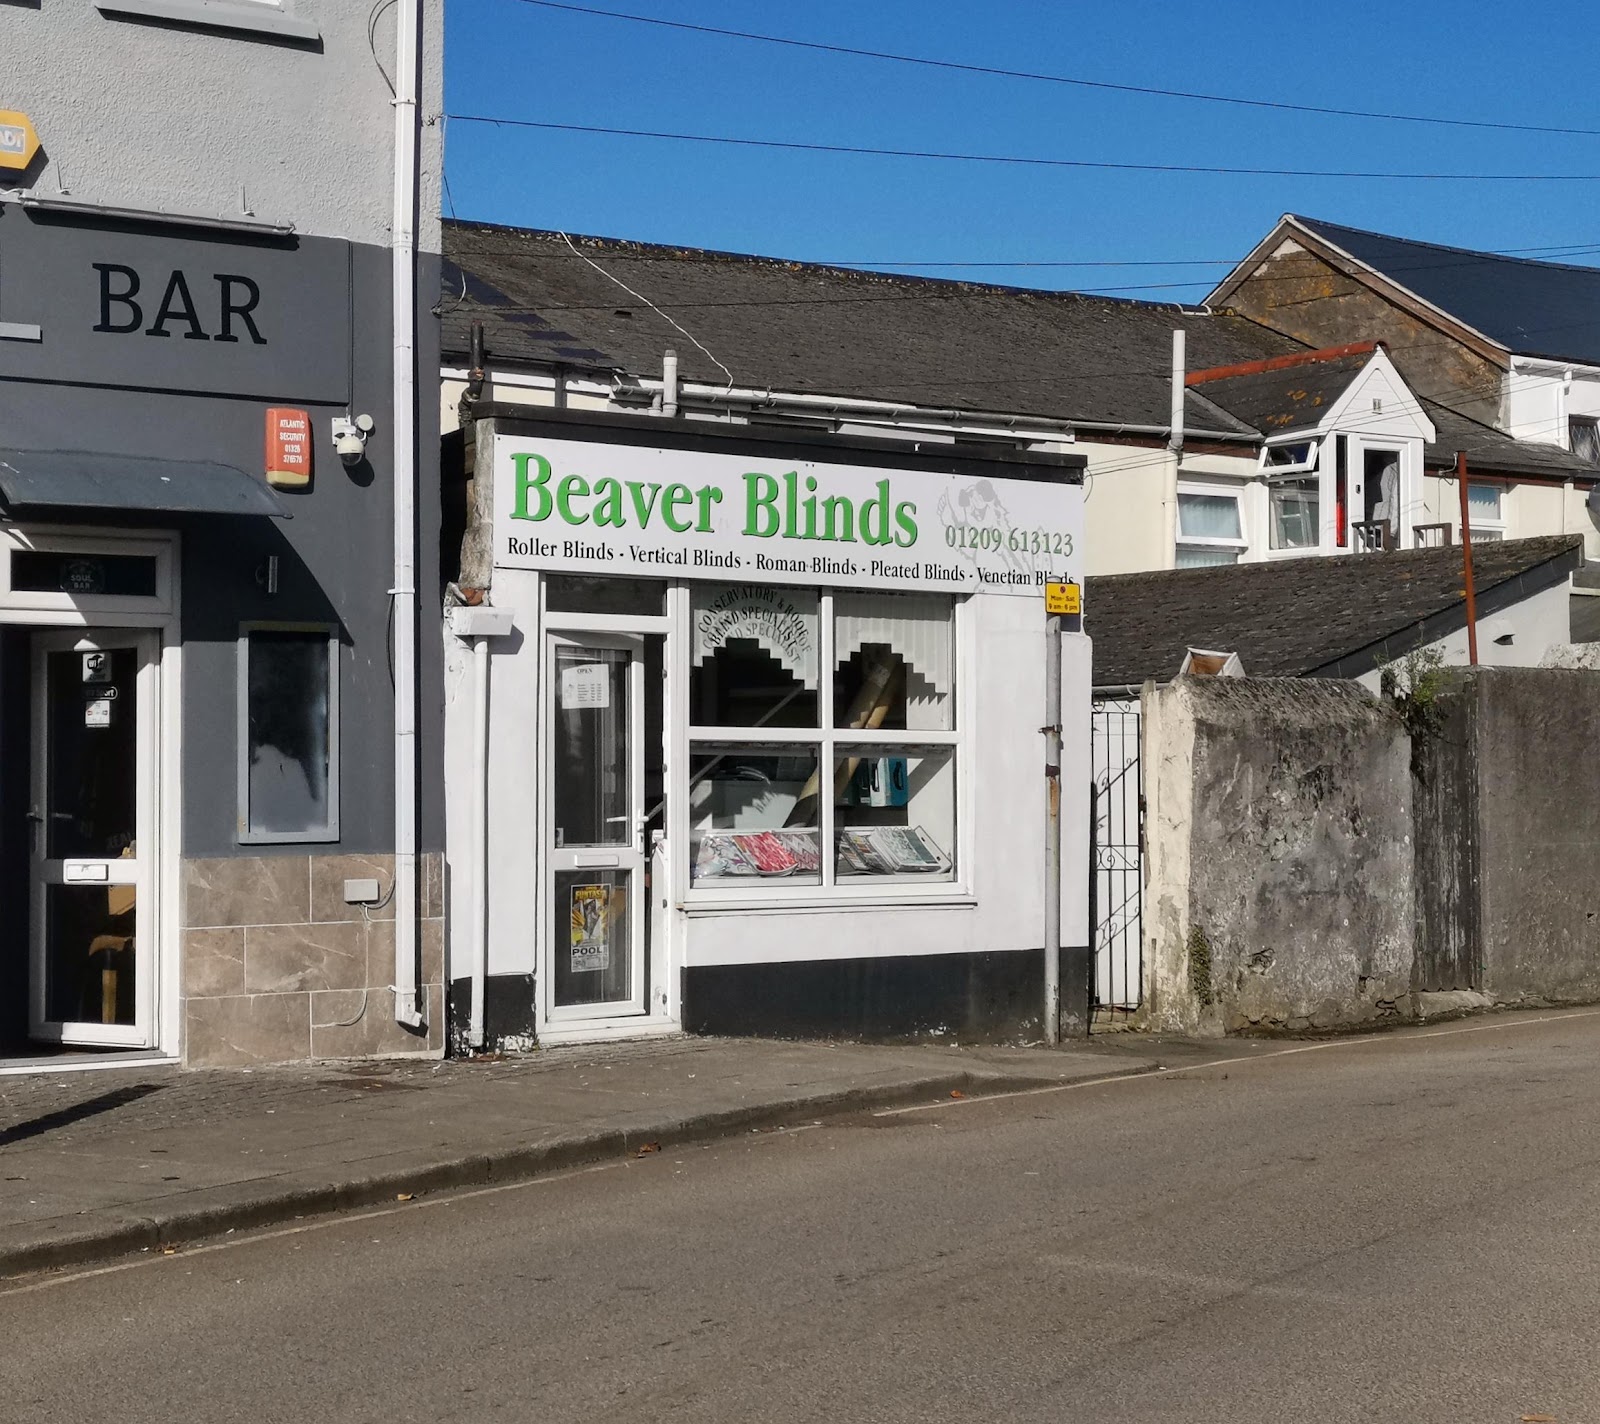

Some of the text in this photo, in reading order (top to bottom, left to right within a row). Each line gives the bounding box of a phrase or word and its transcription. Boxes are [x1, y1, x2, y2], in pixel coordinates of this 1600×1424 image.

[92, 262, 267, 345] BAR
[280, 419, 305, 429] ATLANTIC
[280, 432, 305, 442] SECURITY
[509, 452, 918, 548] Beaver Blinds
[508, 537, 557, 557] Roller
[563, 540, 614, 561] Blinds
[629, 544, 687, 566] Vertical
[693, 549, 741, 569] Blinds
[756, 553, 806, 574] Roman
[812, 557, 857, 576] Blinds
[871, 560, 920, 580] Pleated
[925, 564, 965, 582] Blinds
[977, 567, 1031, 585] Venetian
[1035, 570, 1074, 586] Blds
[945, 525, 1073, 557] 01209 613123
[698, 585, 778, 633] CONSERVATORY
[785, 604, 809, 636] ROOF
[711, 605, 798, 650] BLIND SPECIALIST
[572, 946, 603, 956] POOL
